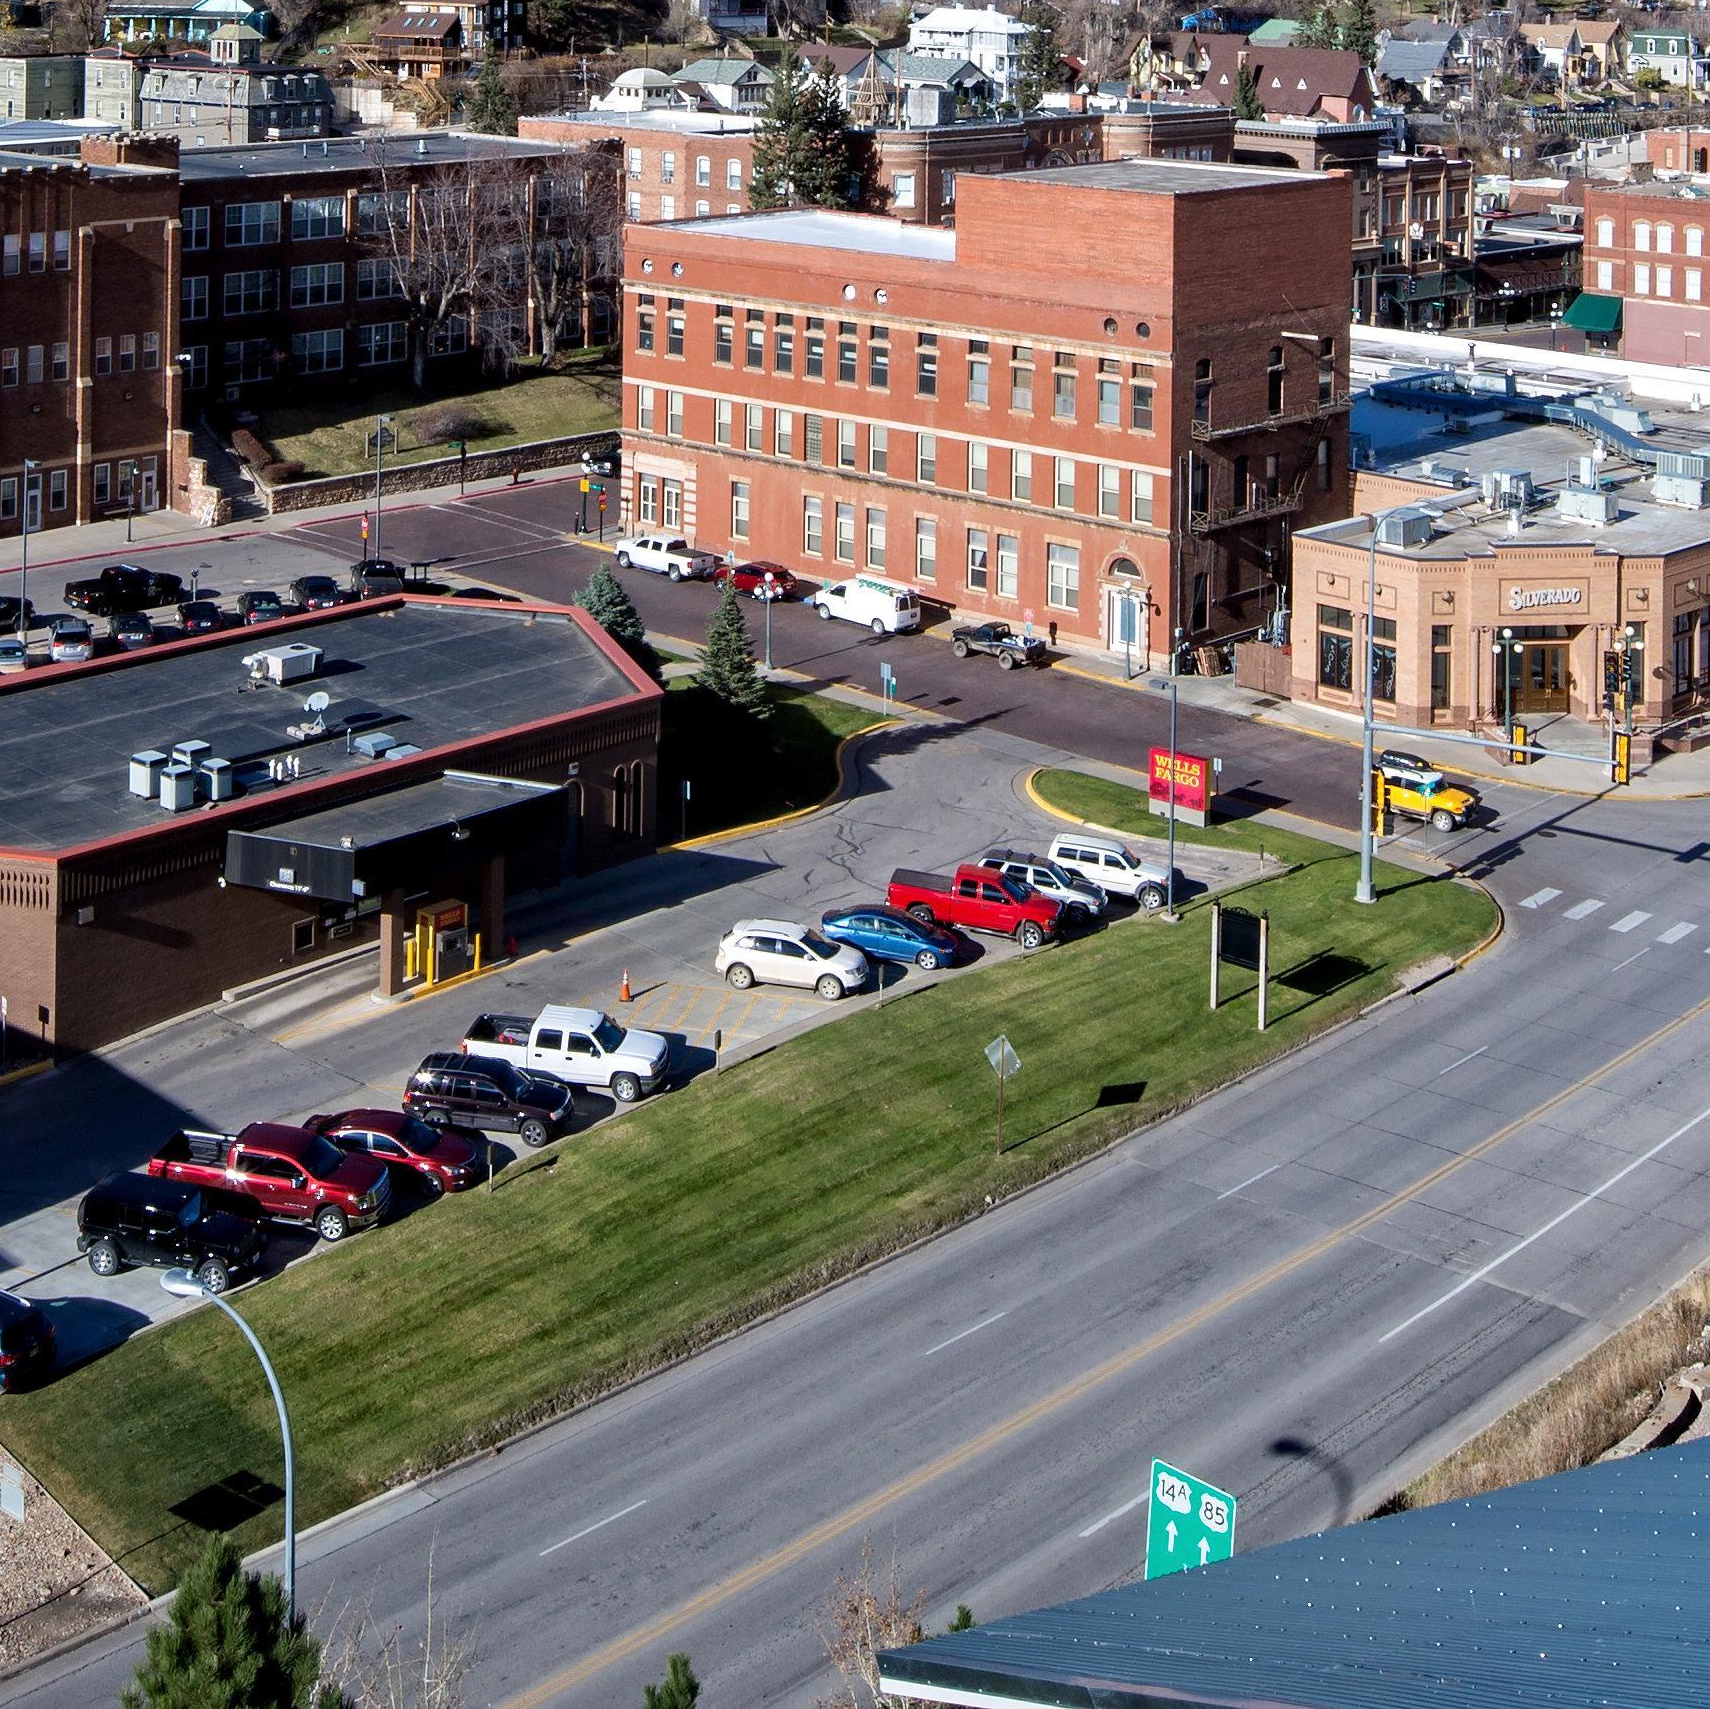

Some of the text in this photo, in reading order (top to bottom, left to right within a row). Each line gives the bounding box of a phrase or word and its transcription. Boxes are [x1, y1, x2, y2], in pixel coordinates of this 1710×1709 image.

[1508, 586, 1581, 610] SILVERADO
[1155, 754, 1200, 776] WELLS
[1155, 767, 1200, 788] FARGO
[1161, 1478, 1187, 1503] 14A
[1203, 1501, 1225, 1526] 85
